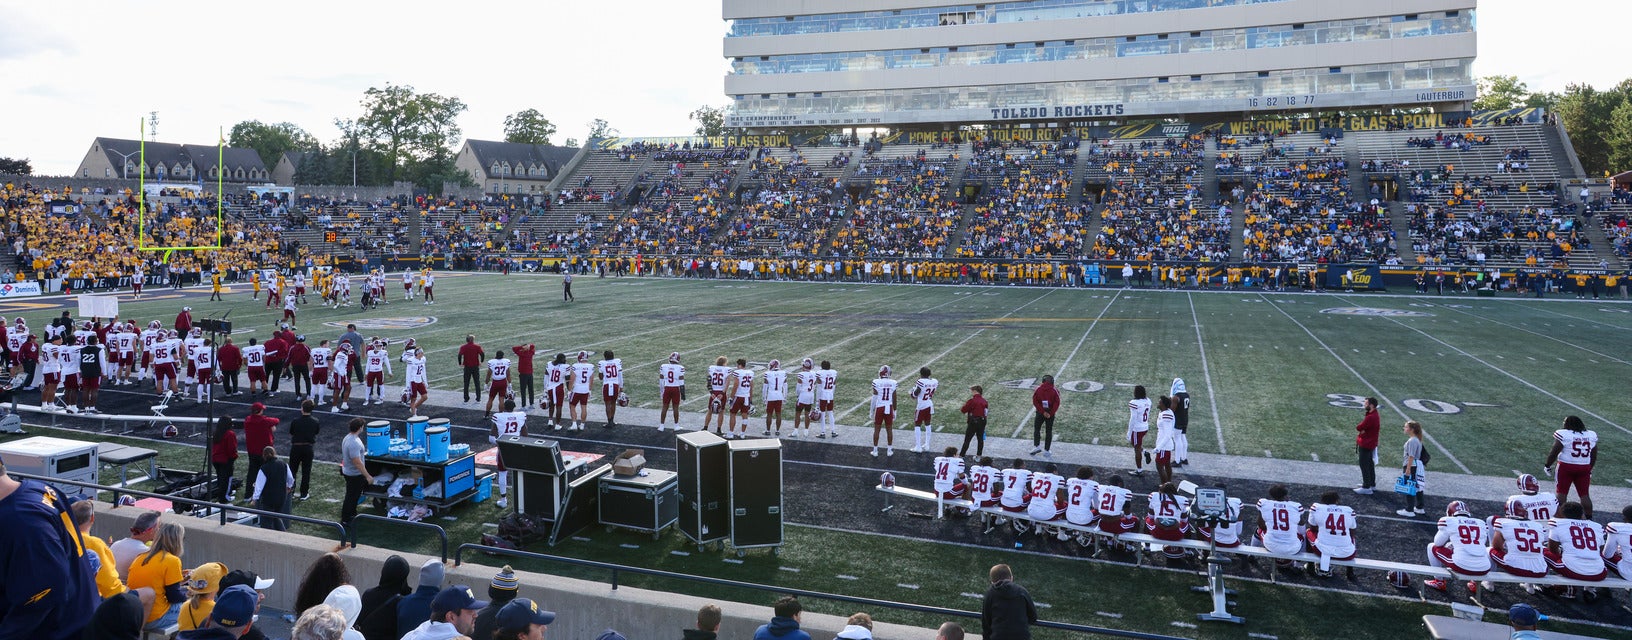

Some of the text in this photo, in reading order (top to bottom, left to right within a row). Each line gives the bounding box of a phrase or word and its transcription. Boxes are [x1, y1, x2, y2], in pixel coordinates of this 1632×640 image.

[1248, 95, 1315, 107] 16 82 18 77
[1416, 91, 1464, 101] LAUTERBUR
[991, 104, 1124, 119] TOLEDO ROCKETS
[1230, 120, 1293, 134] WELCOME
[1300, 119, 1315, 132] TO
[1351, 115, 1398, 131] GLASS
[1403, 114, 1446, 129] BOWL
[708, 137, 725, 147] THE
[728, 136, 760, 147] GLASS
[763, 135, 792, 147] BOWL
[909, 131, 938, 144] HOME
[992, 129, 1033, 142] TOLEDO
[326, 232, 336, 242] 38
[1340, 274, 1372, 285] TLEDO
[15, 284, 38, 293] Domino's
[121, 339, 129, 347] 17
[82, 353, 95, 363] 22
[155, 348, 168, 358] 85
[198, 353, 209, 363] 45
[248, 352, 260, 363] 30
[313, 354, 324, 365] 32
[494, 366, 506, 376] 37
[550, 370, 561, 382] 18
[582, 371, 587, 383] 5
[605, 365, 617, 378] 50
[668, 371, 674, 383] 9
[712, 373, 723, 386] 26
[741, 376, 752, 388] 25
[775, 378, 778, 390] 1
[807, 379, 813, 392] 3
[824, 377, 833, 389] 12
[882, 388, 889, 400] 11
[922, 389, 935, 400] 24
[1143, 408, 1149, 422] 6
[504, 422, 518, 434] 13
[1572, 441, 1591, 458] 53
[936, 463, 950, 480] 14
[973, 473, 989, 493] 28
[1008, 476, 1017, 488] 7
[1032, 480, 1051, 499] 23
[1072, 486, 1082, 505] 2
[1101, 493, 1116, 511] 21
[1159, 500, 1174, 516] 15
[1272, 509, 1289, 531] 19
[1532, 508, 1550, 520] 10
[1325, 513, 1347, 536] 44
[1458, 525, 1480, 545] 97
[1514, 528, 1540, 553] 52
[1570, 526, 1598, 551] 88
